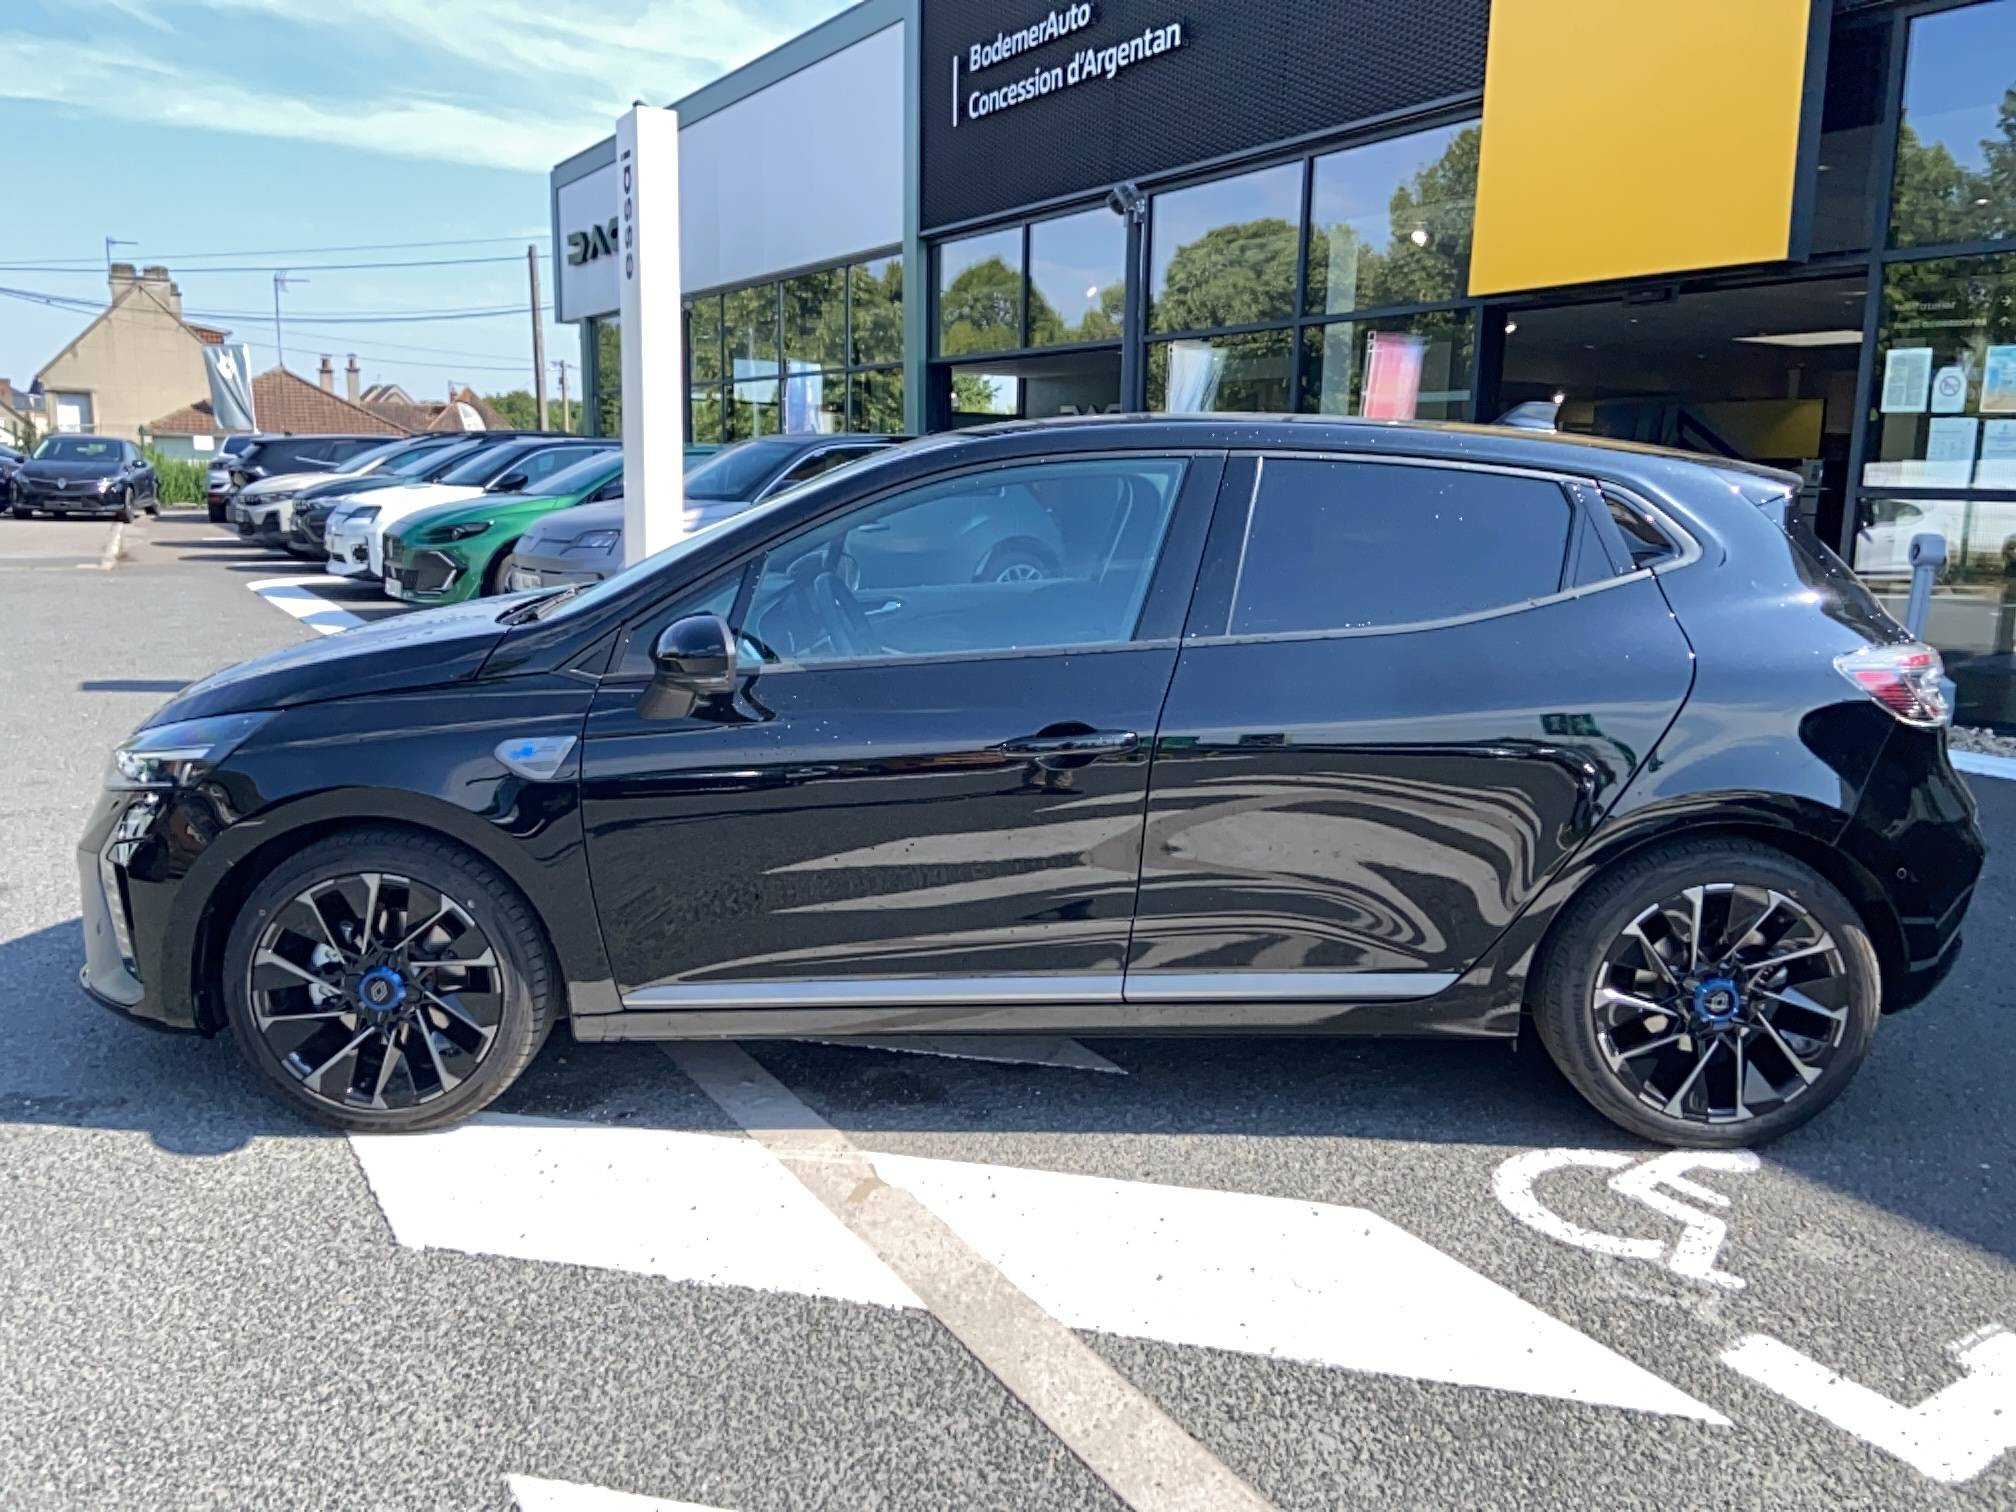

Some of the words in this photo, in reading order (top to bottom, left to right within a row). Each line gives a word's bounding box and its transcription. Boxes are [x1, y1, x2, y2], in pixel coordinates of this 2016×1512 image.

[969, 2, 1091, 72] BodemerAuto
[969, 66, 1063, 119] Concession
[1067, 22, 1182, 80] d'Argentan
